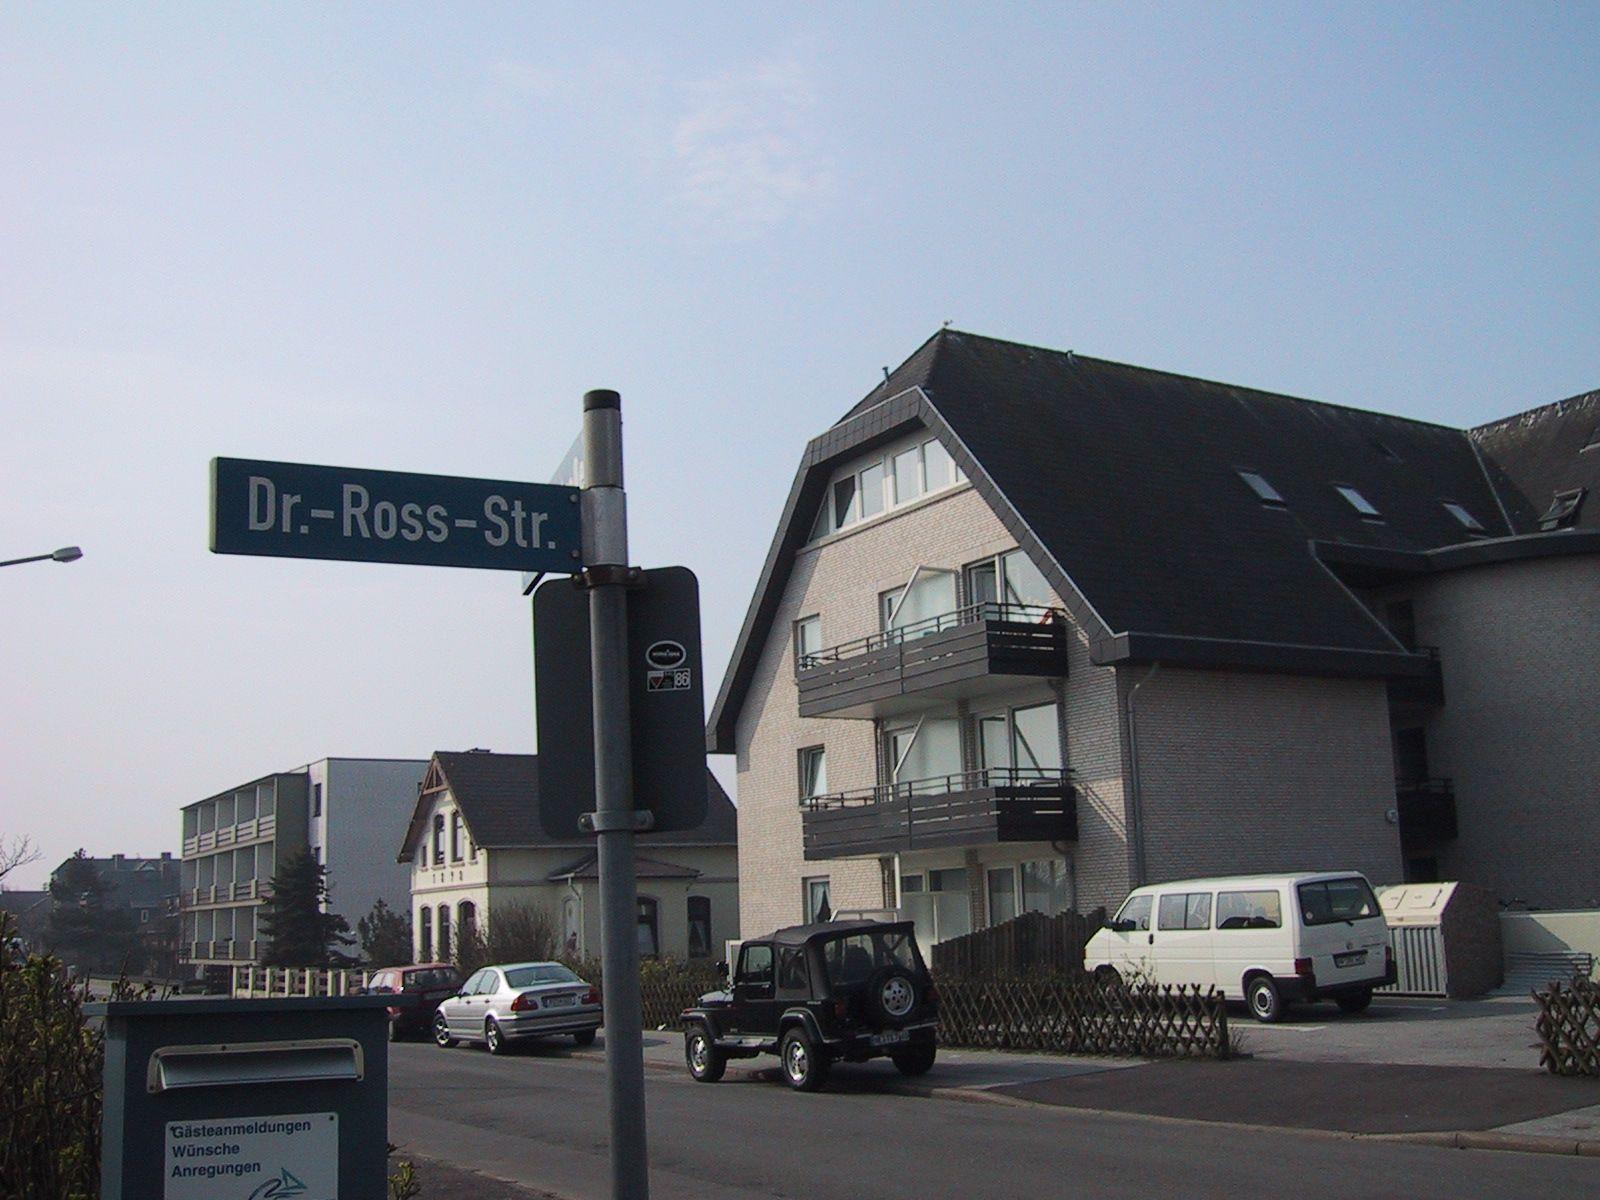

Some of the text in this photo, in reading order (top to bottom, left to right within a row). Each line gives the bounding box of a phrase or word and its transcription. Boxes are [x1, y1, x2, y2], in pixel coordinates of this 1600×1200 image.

[247, 475, 557, 550] Dr.-Ross-Str.
[675, 672, 689, 686] 86
[172, 1120, 312, 1139] Gästeanmeldungen
[172, 1143, 240, 1158] Wünsche
[171, 1161, 262, 1179] Anregungen
